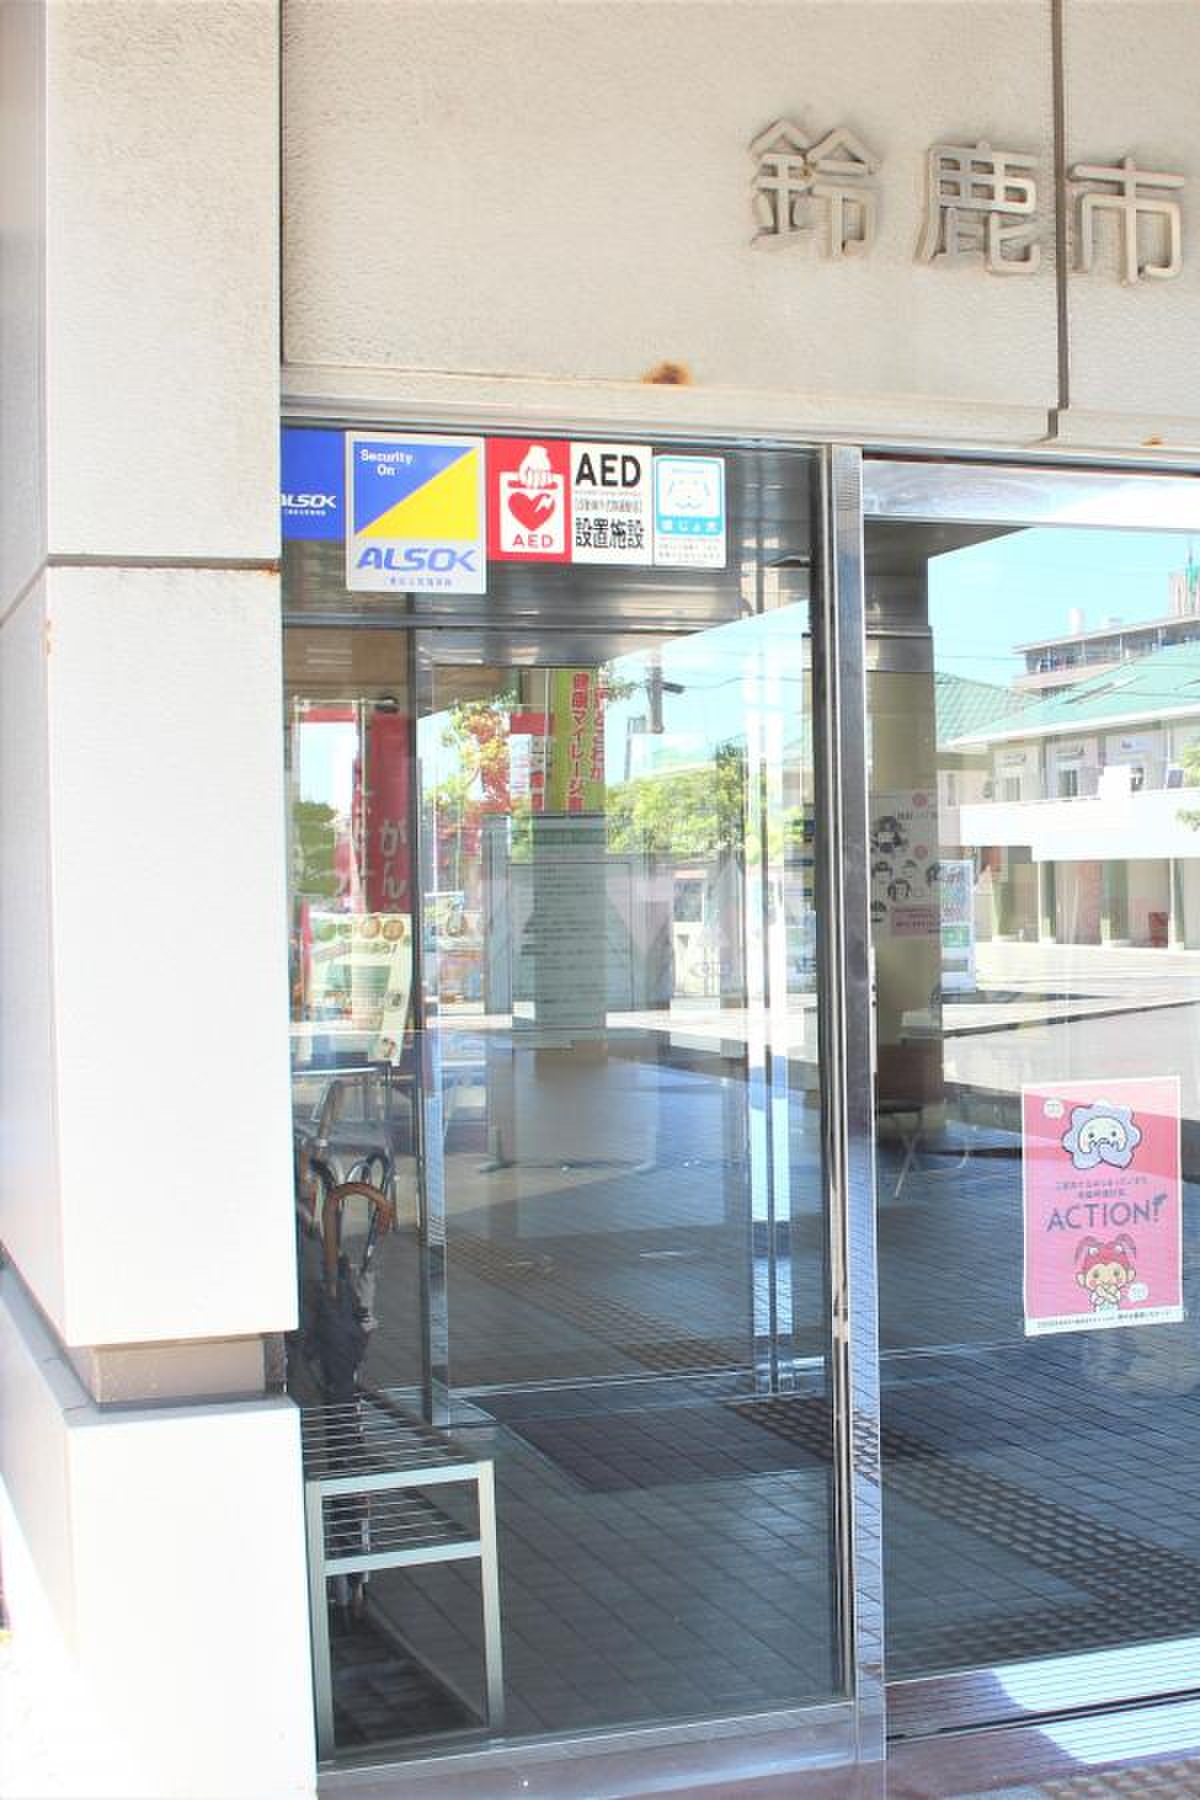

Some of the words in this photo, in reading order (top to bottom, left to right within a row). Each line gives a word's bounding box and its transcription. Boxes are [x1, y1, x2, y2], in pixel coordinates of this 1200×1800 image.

[360, 449, 413, 464] Security
[377, 464, 396, 476] On
[575, 453, 641, 487] AED
[512, 534, 554, 548] AED
[576, 517, 645, 549] 設置施設
[356, 547, 476, 572] ALSOK
